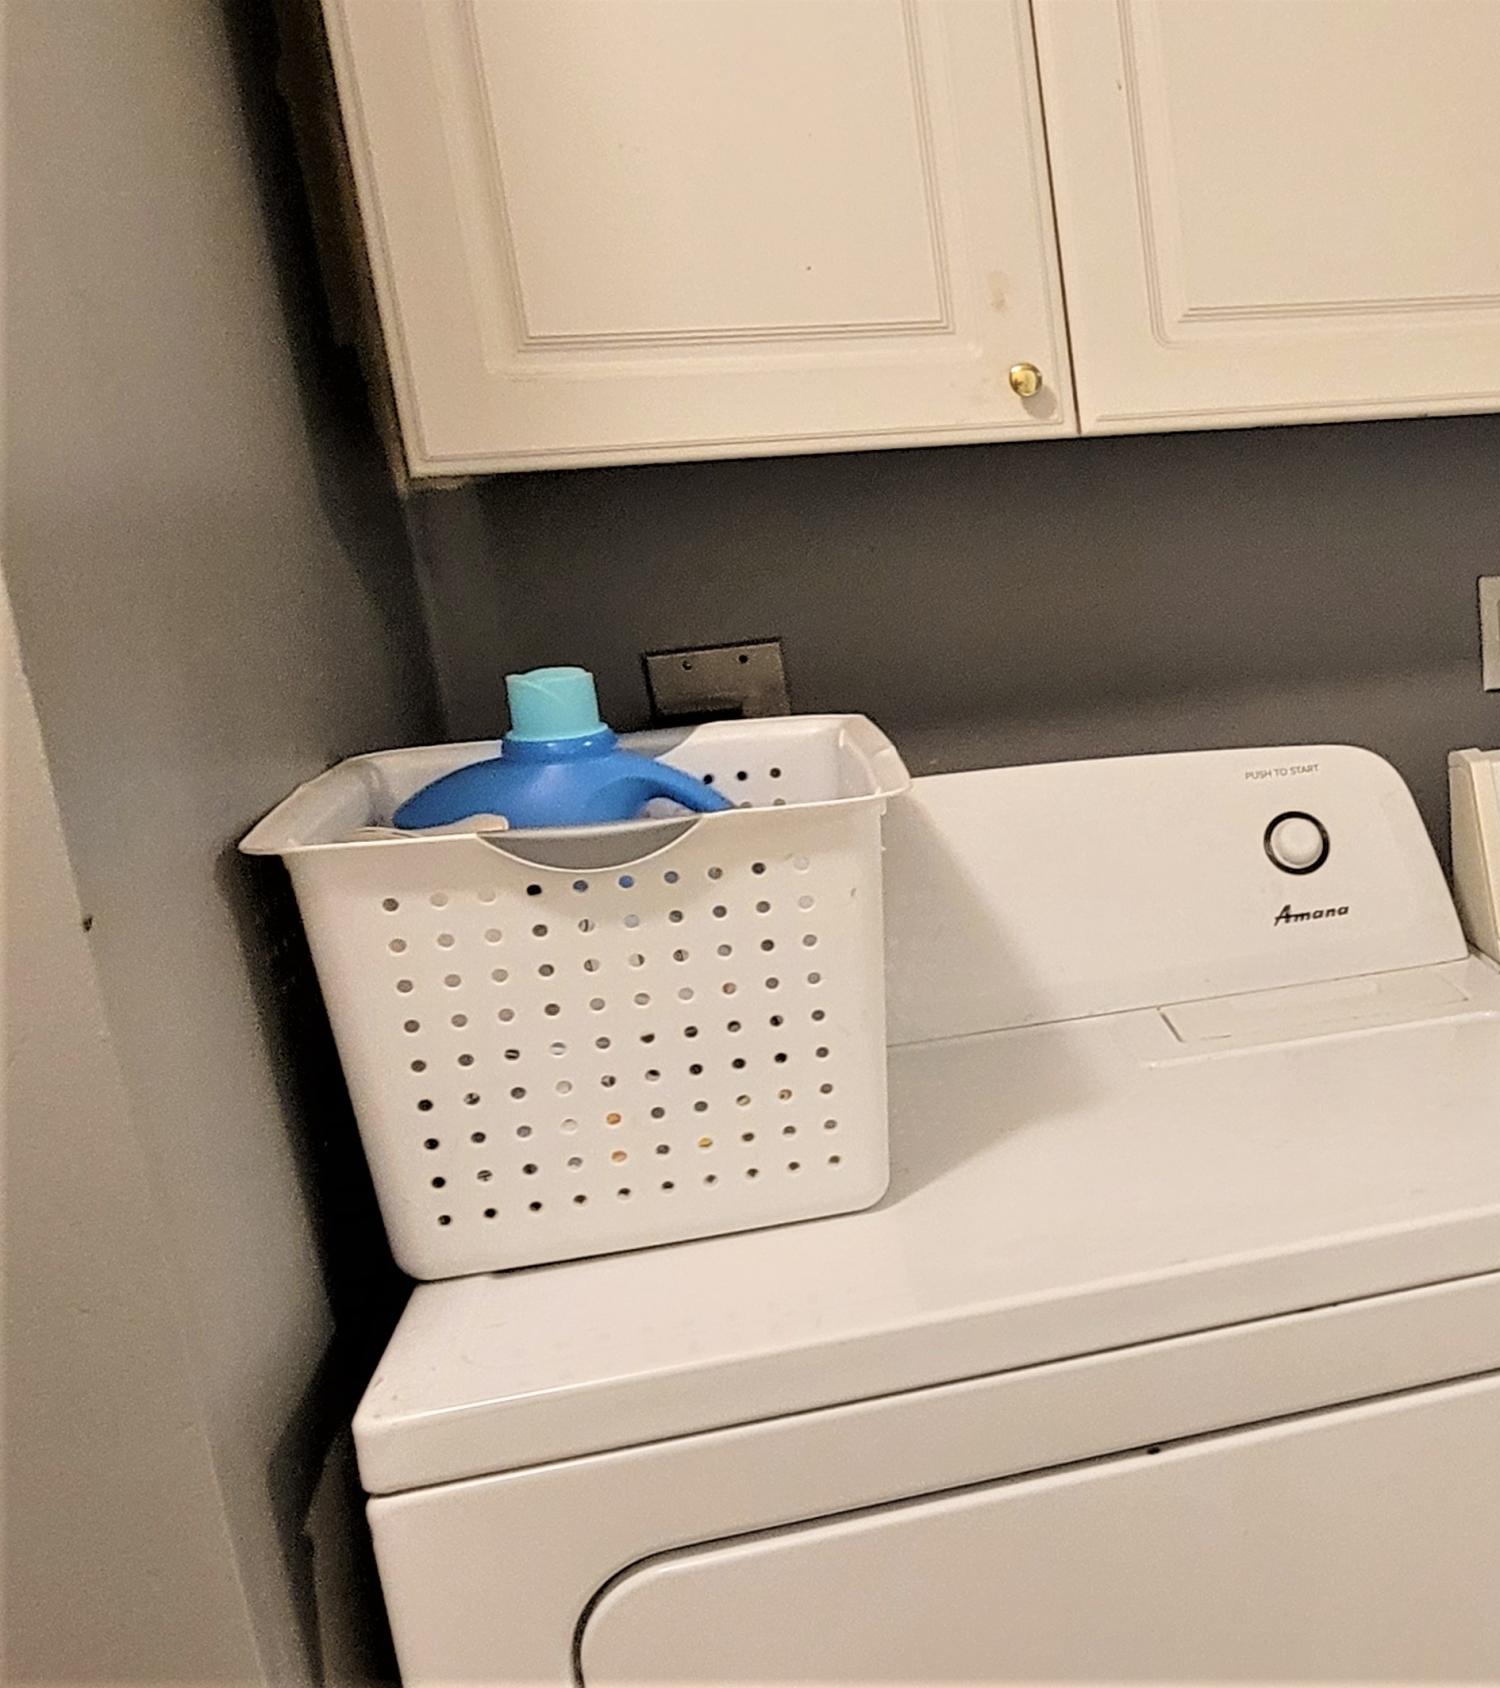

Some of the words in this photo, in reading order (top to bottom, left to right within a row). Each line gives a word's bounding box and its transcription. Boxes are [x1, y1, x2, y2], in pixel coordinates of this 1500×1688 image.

[1244, 769, 1273, 781] PUSH
[1274, 767, 1288, 777] TO
[1289, 763, 1320, 776] START
[1273, 904, 1350, 927] Amana
